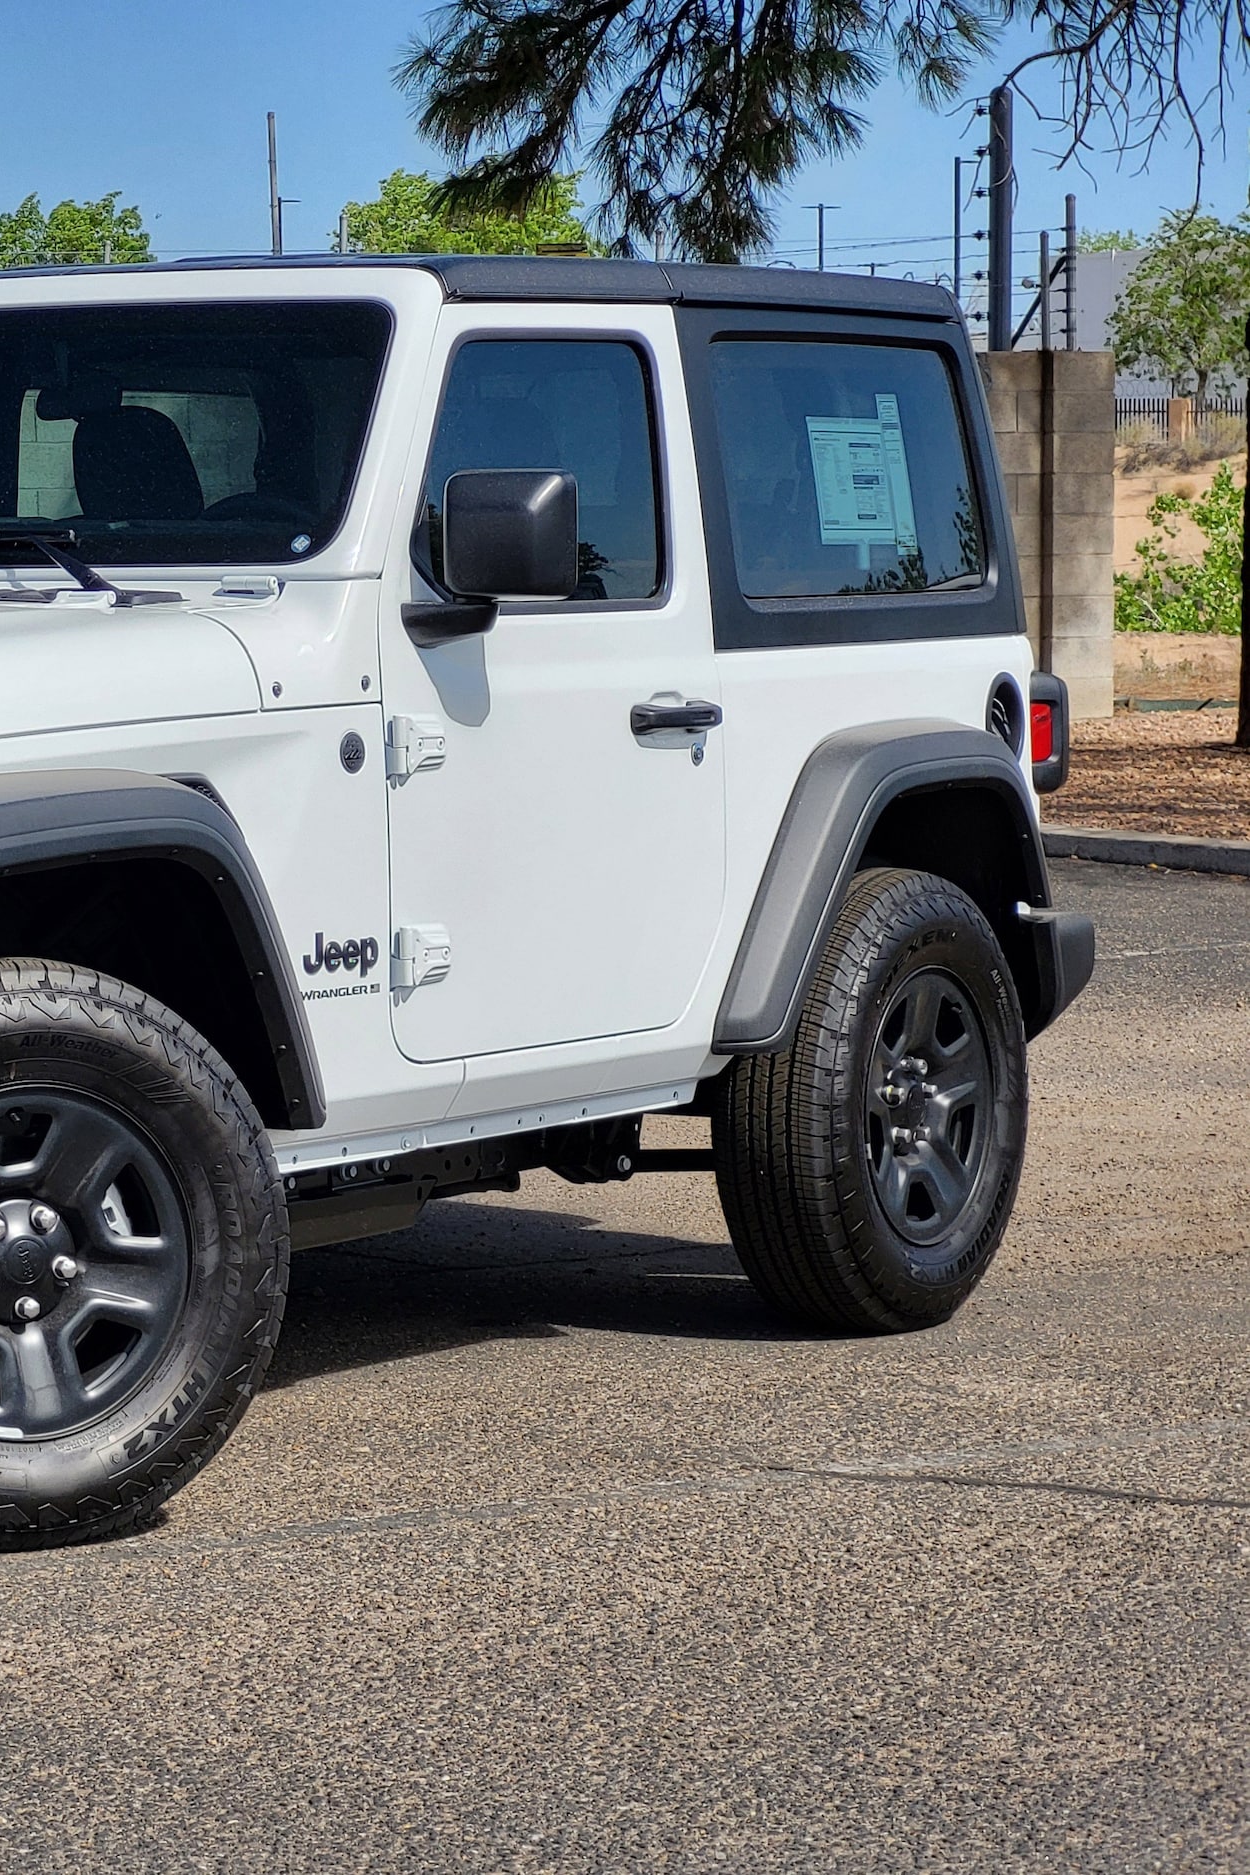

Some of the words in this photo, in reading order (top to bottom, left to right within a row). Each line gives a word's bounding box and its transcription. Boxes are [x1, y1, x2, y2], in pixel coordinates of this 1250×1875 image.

[303, 932, 379, 978] Jeep
[300, 985, 368, 1001] WRANGLER
[19, 1034, 120, 1057] All-Weather
[123, 1369, 206, 1461] HTX2
